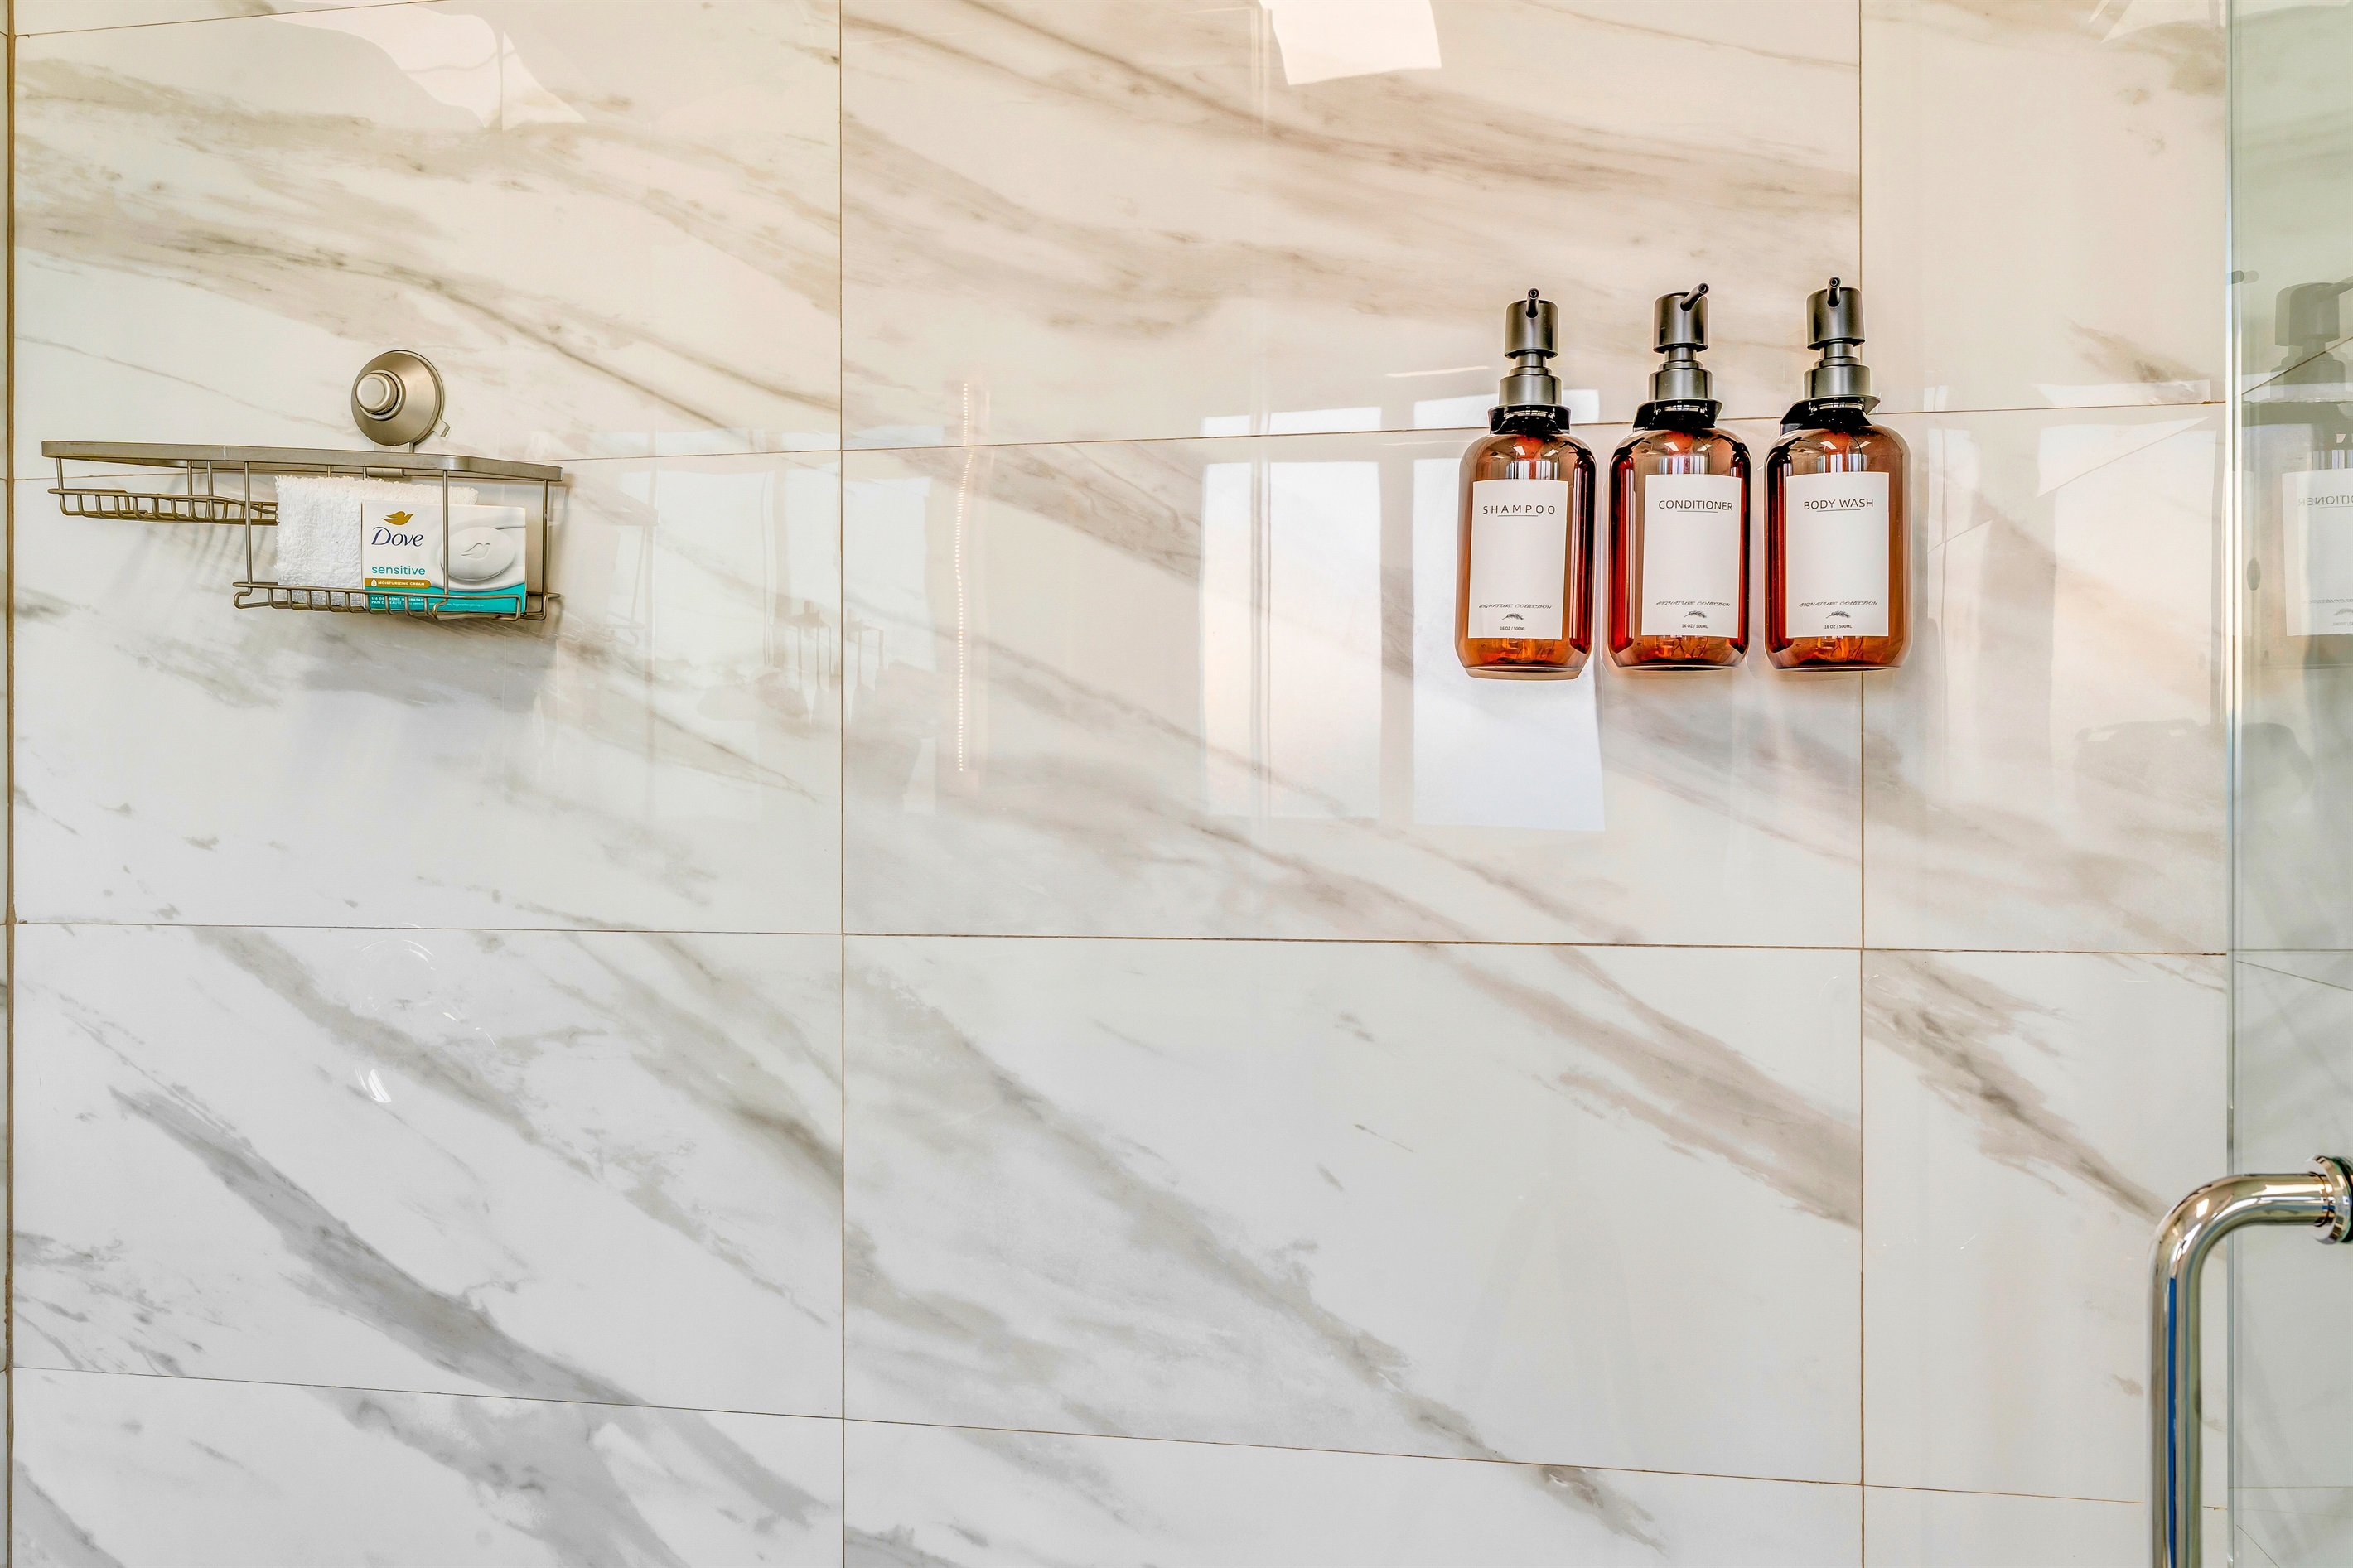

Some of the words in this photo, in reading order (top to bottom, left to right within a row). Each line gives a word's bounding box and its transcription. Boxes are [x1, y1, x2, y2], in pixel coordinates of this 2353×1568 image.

[1482, 504, 1556, 514] SHAMPOO
[1658, 499, 1733, 511] CONDITIONER
[1804, 499, 1836, 510] BODY
[1839, 499, 1874, 508] WASH
[371, 526, 424, 548] Dove
[371, 565, 426, 576] sensitive
